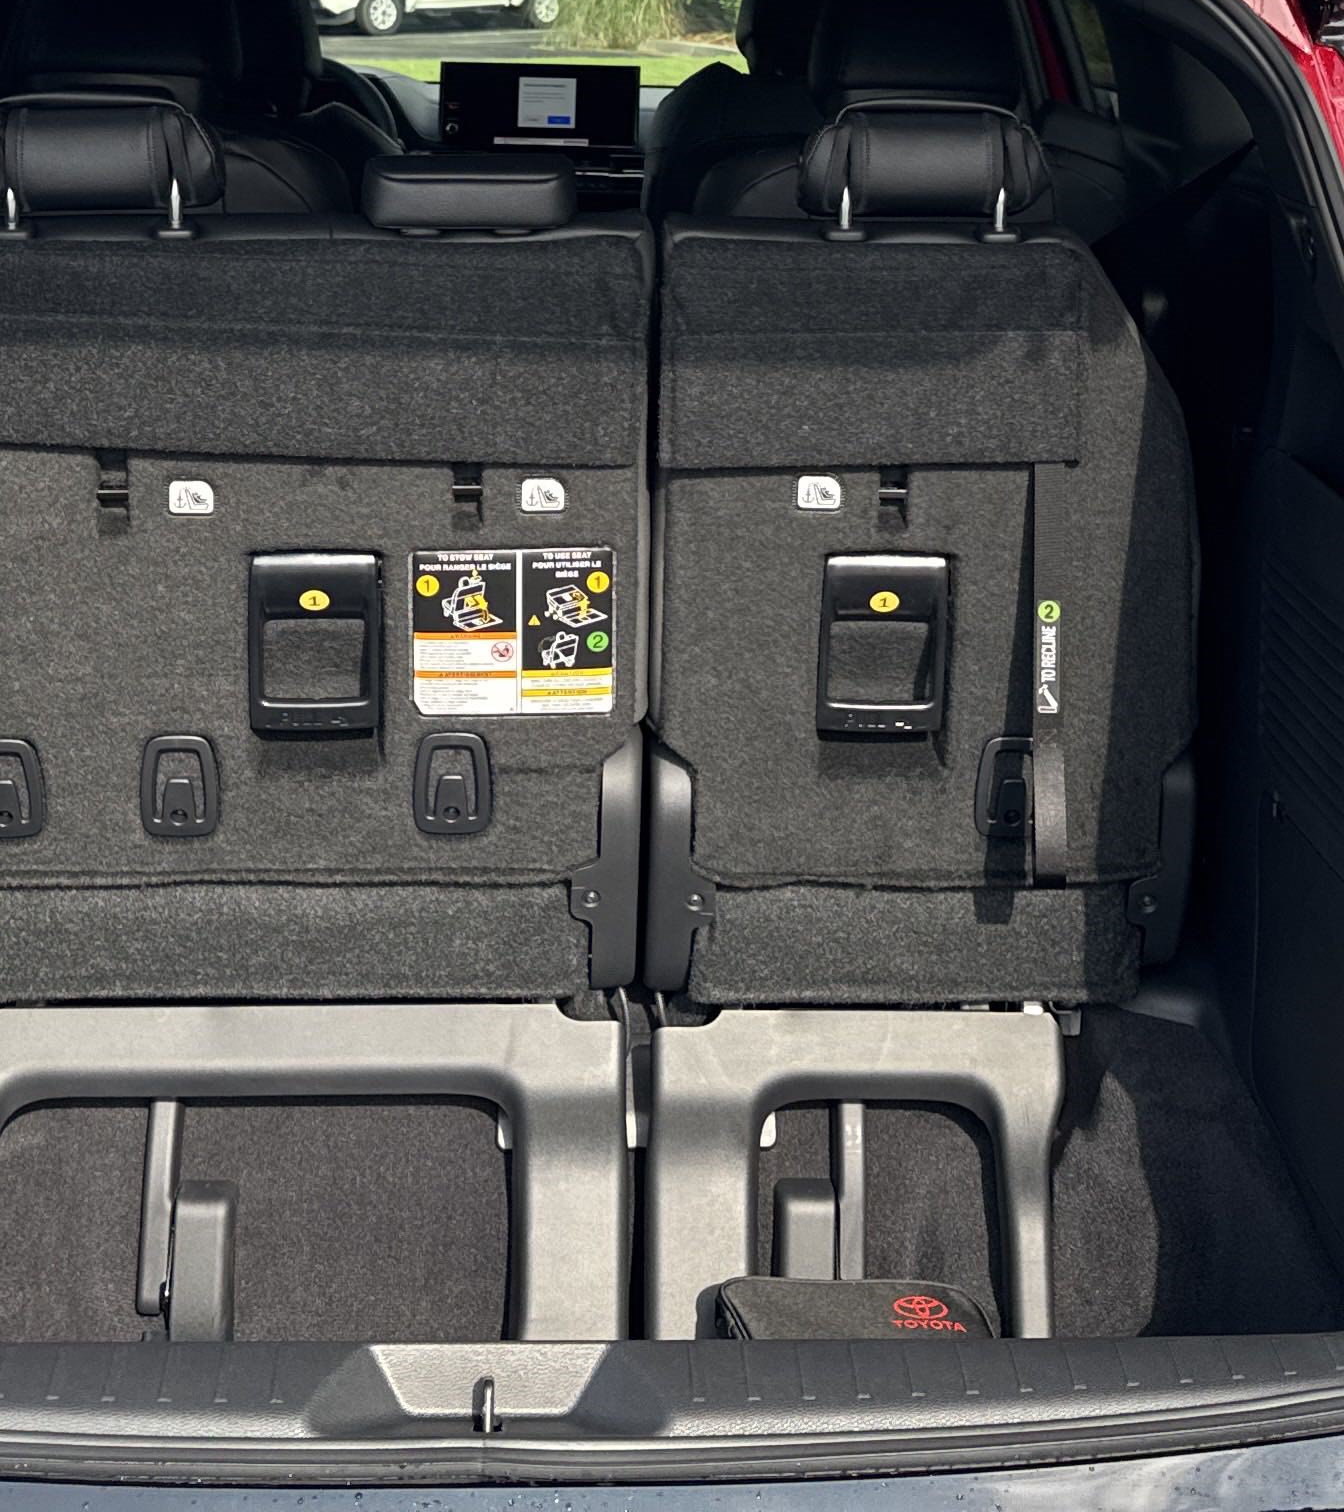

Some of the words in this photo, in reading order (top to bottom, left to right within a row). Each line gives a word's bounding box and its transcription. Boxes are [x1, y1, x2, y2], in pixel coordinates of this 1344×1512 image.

[474, 553, 494, 561] SEAT
[542, 552, 554, 560] TO
[572, 551, 592, 559] SEAT
[419, 563, 442, 571] POUR
[591, 560, 602, 568] LE
[423, 579, 430, 592] 1
[594, 575, 601, 589] 1
[1044, 604, 1054, 619] 2
[591, 634, 604, 648] 2
[1041, 669, 1056, 682] TO
[891, 1319, 968, 1333] TOYOTA
